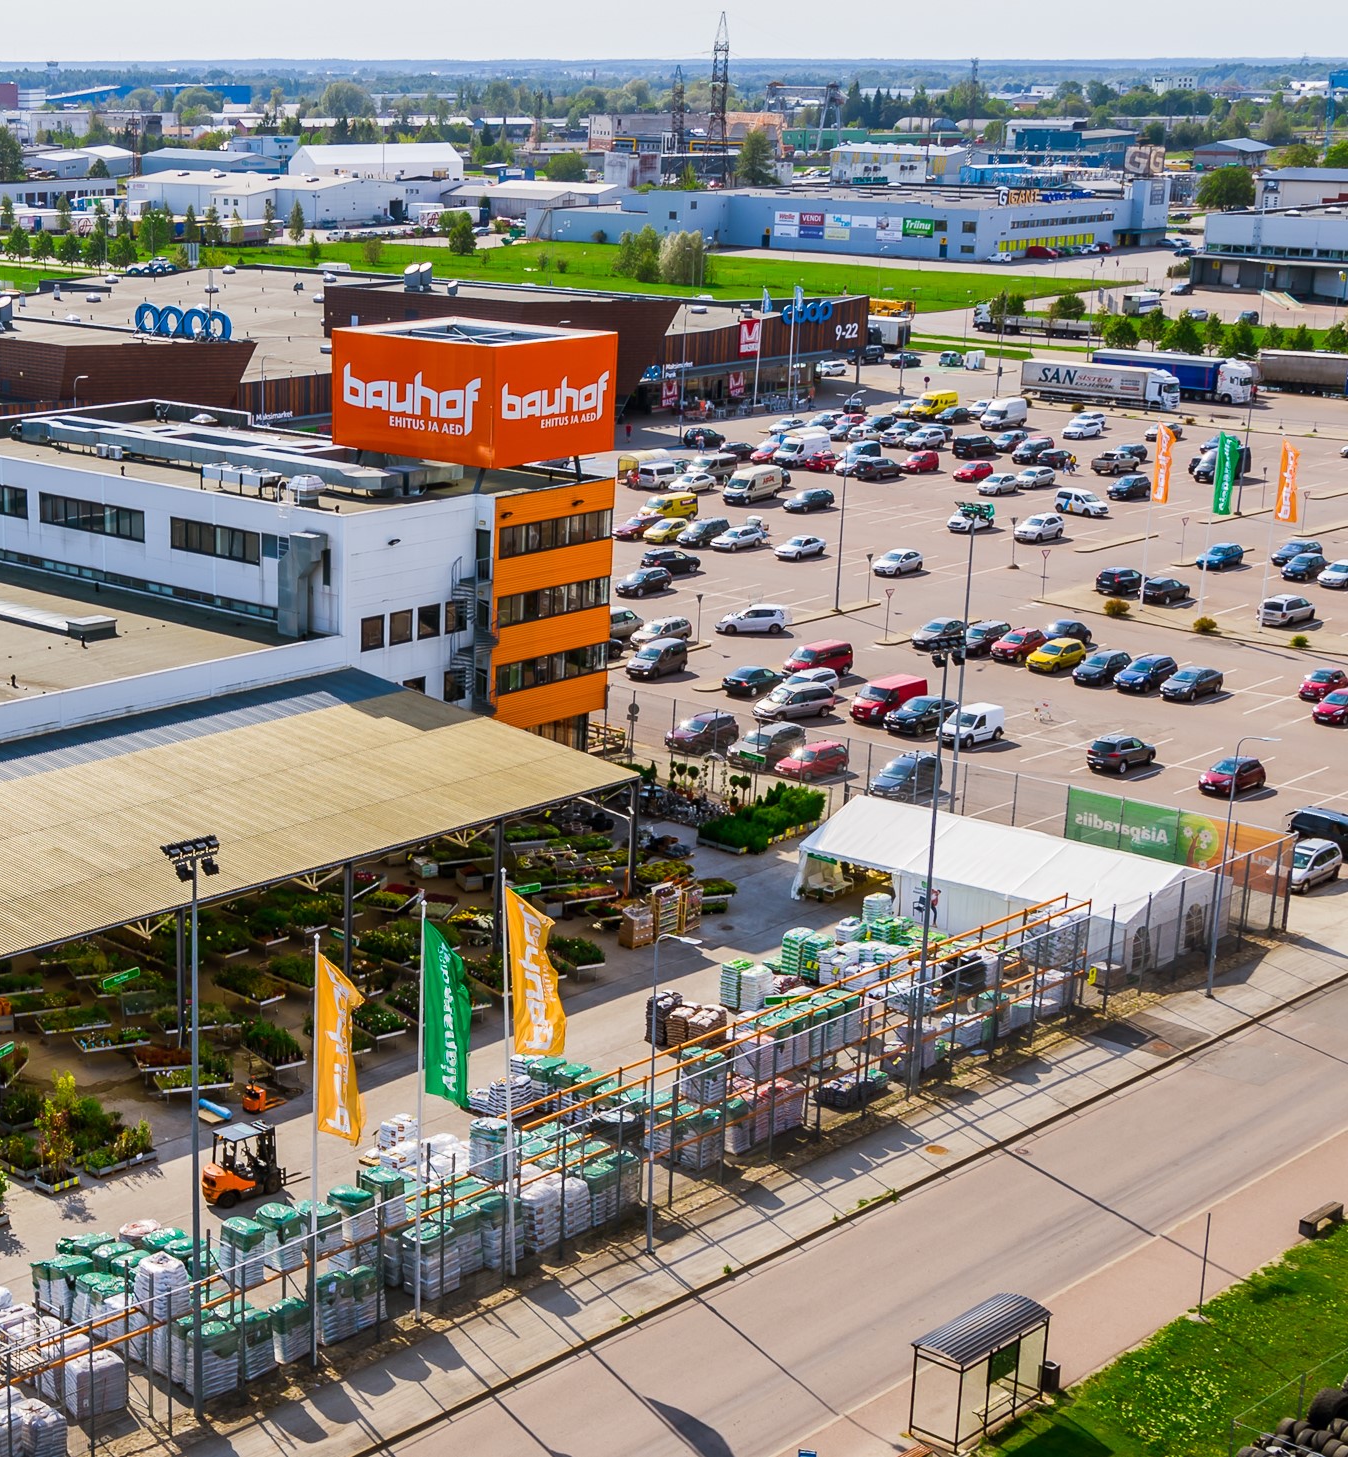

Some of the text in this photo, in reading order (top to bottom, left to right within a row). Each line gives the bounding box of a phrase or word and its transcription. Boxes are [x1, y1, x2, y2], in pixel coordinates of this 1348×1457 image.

[802, 214, 822, 222] VENDI
[905, 219, 931, 230] Triinu
[835, 323, 859, 341] 9-22
[1038, 367, 1078, 386] SAN
[343, 362, 482, 436] bauhof
[501, 370, 610, 421] bauhof
[389, 415, 464, 436] EHITUS JA AED
[540, 412, 597, 429] EHITUS JA AED
